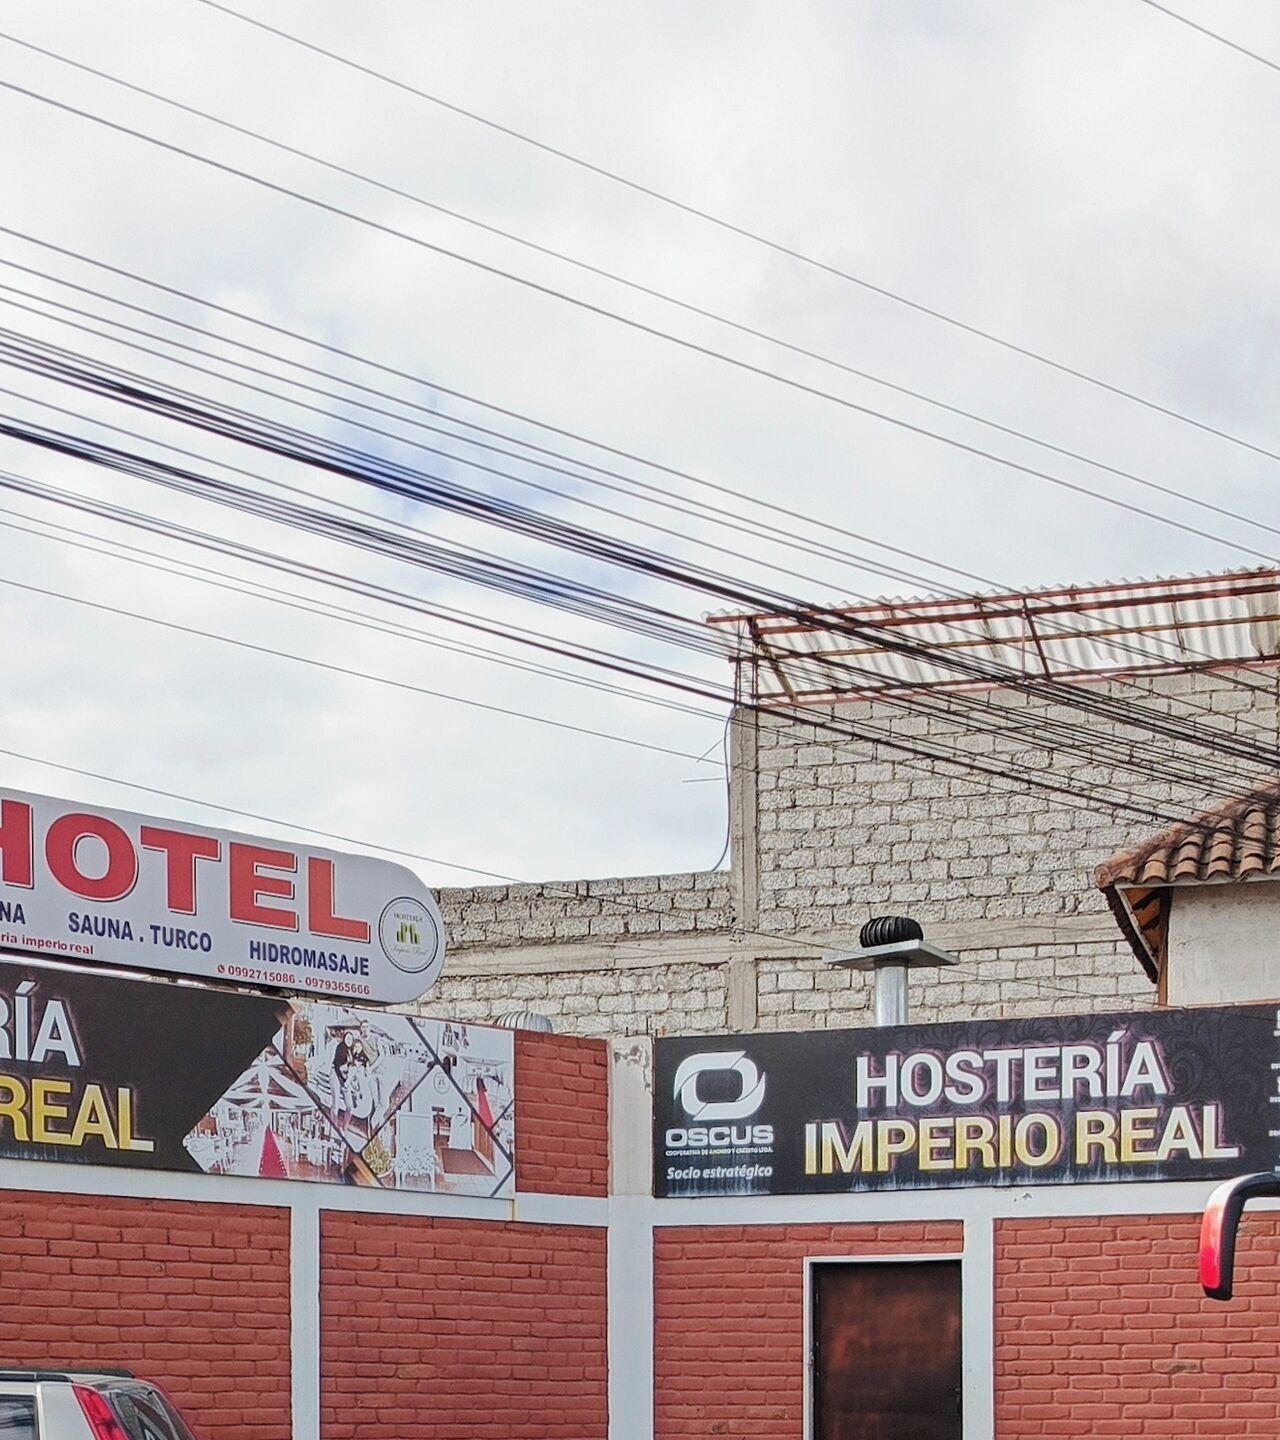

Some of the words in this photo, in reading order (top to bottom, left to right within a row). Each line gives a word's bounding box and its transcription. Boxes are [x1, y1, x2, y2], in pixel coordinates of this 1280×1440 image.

[22, 935, 67, 951] imperio
[70, 945, 94, 955] real
[68, 912, 134, 941] SAUNA
[150, 925, 212, 952] TURCO
[249, 940, 370, 976] HIDROMASAJE
[228, 965, 295, 983] 0992715086
[856, 1030, 1168, 1108] HOSTERÍA
[665, 1125, 774, 1146] OSCUS
[805, 1113, 1062, 1175] IMPERIO
[1075, 1105, 1239, 1165] REAL
[666, 1166, 701, 1179] Socio
[702, 1164, 773, 1180] estratégico
